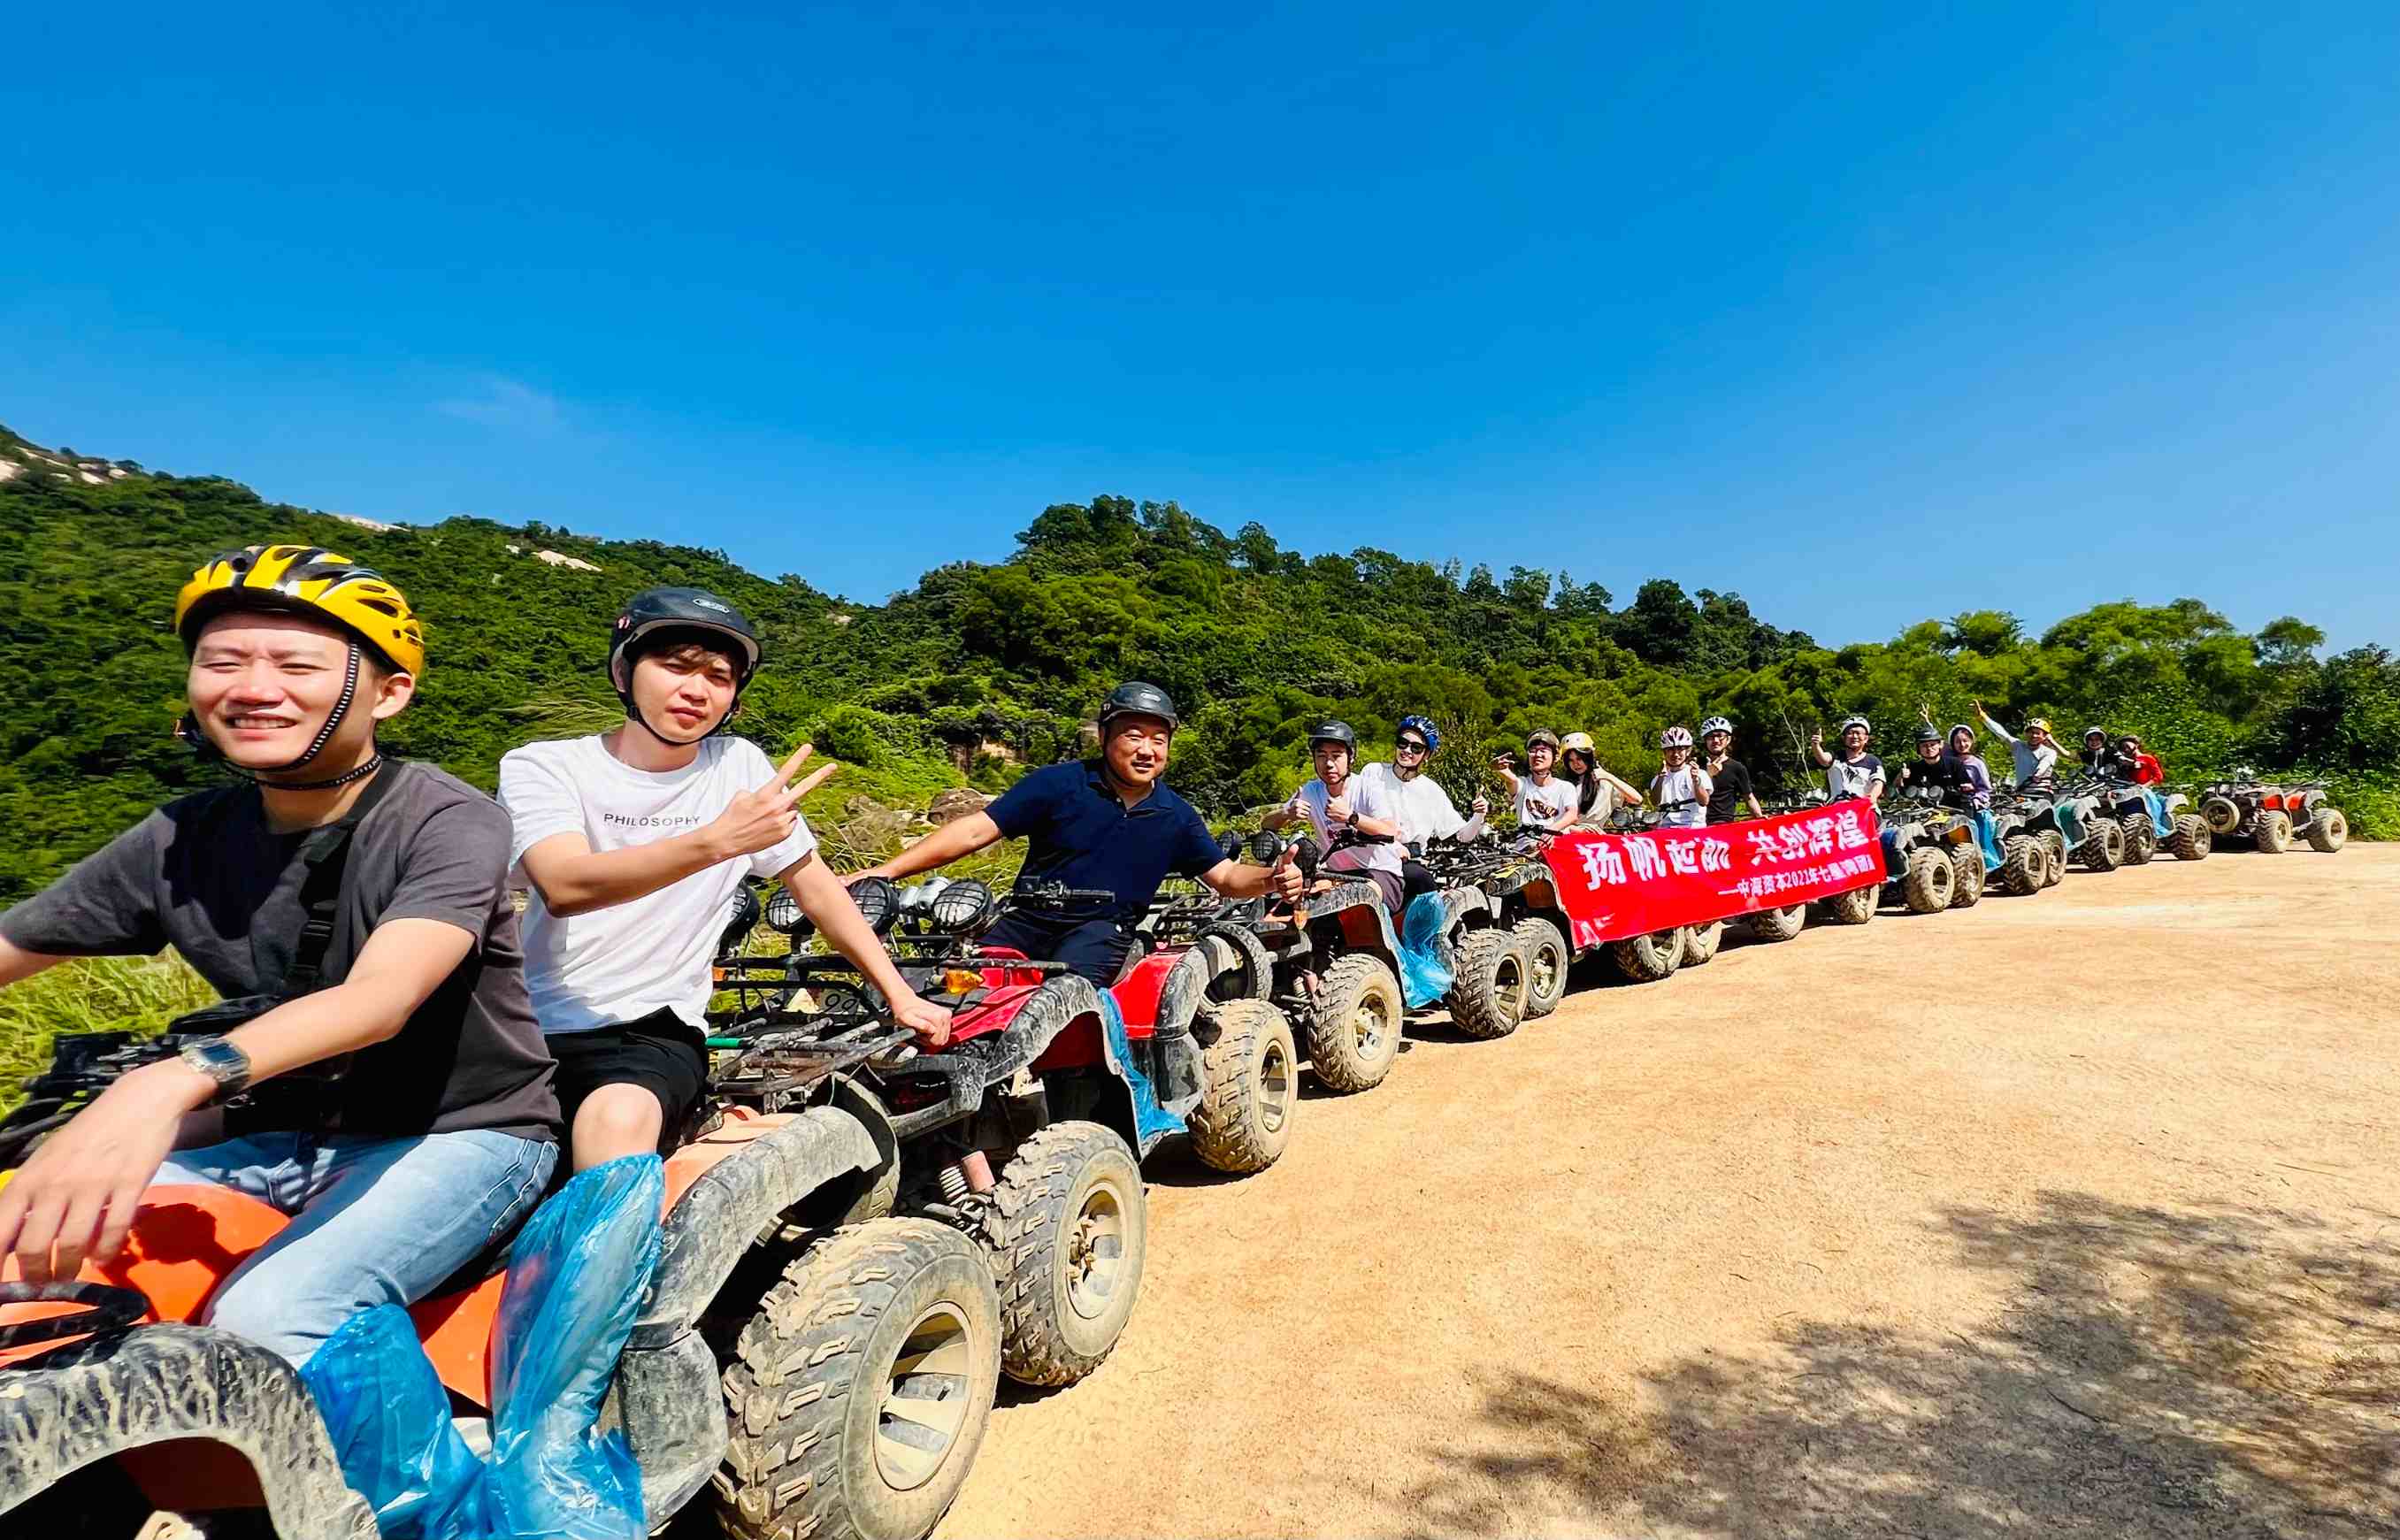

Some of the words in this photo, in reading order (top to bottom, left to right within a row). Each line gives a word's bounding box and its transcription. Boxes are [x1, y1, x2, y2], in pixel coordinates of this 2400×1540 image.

[603, 813, 701, 827] PHILOSOPHY
[1575, 837, 1731, 891] 扬帆起航
[1746, 809, 1869, 866] 共创辉煌
